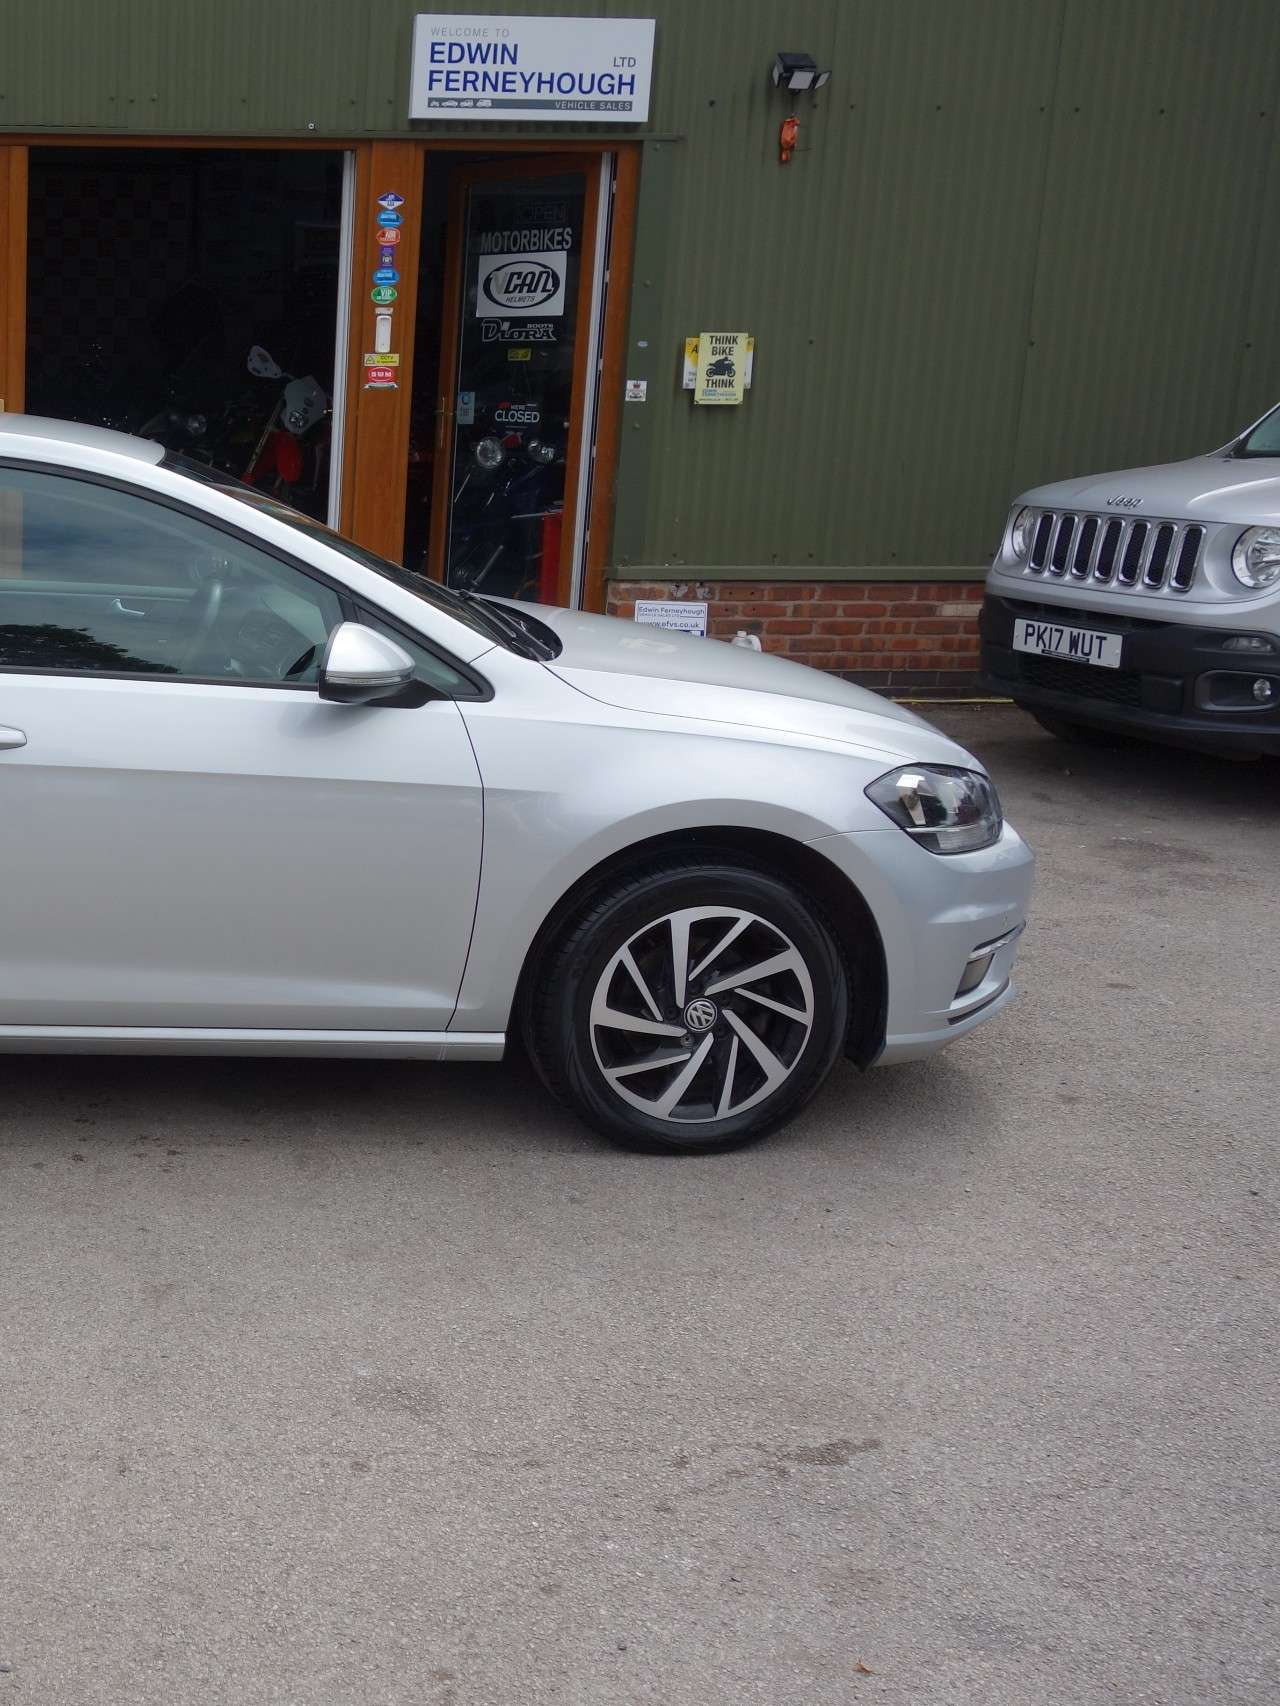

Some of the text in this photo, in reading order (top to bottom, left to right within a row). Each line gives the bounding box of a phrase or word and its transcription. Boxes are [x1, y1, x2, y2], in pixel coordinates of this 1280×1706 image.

[431, 27, 510, 38] WELCOME TO
[430, 42, 518, 65] EDWIN
[613, 56, 636, 68] LTD
[428, 70, 636, 95] FERNEYHOUGH
[555, 101, 631, 111] VEHICLE SALES
[480, 227, 572, 253] MOTORBIKES
[709, 335, 739, 345] THINK
[711, 346, 734, 356] BIKE
[705, 378, 735, 388] THINK
[495, 410, 540, 423] CLOSED
[1023, 623, 1064, 650] PK17
[1070, 632, 1108, 660] WUT
